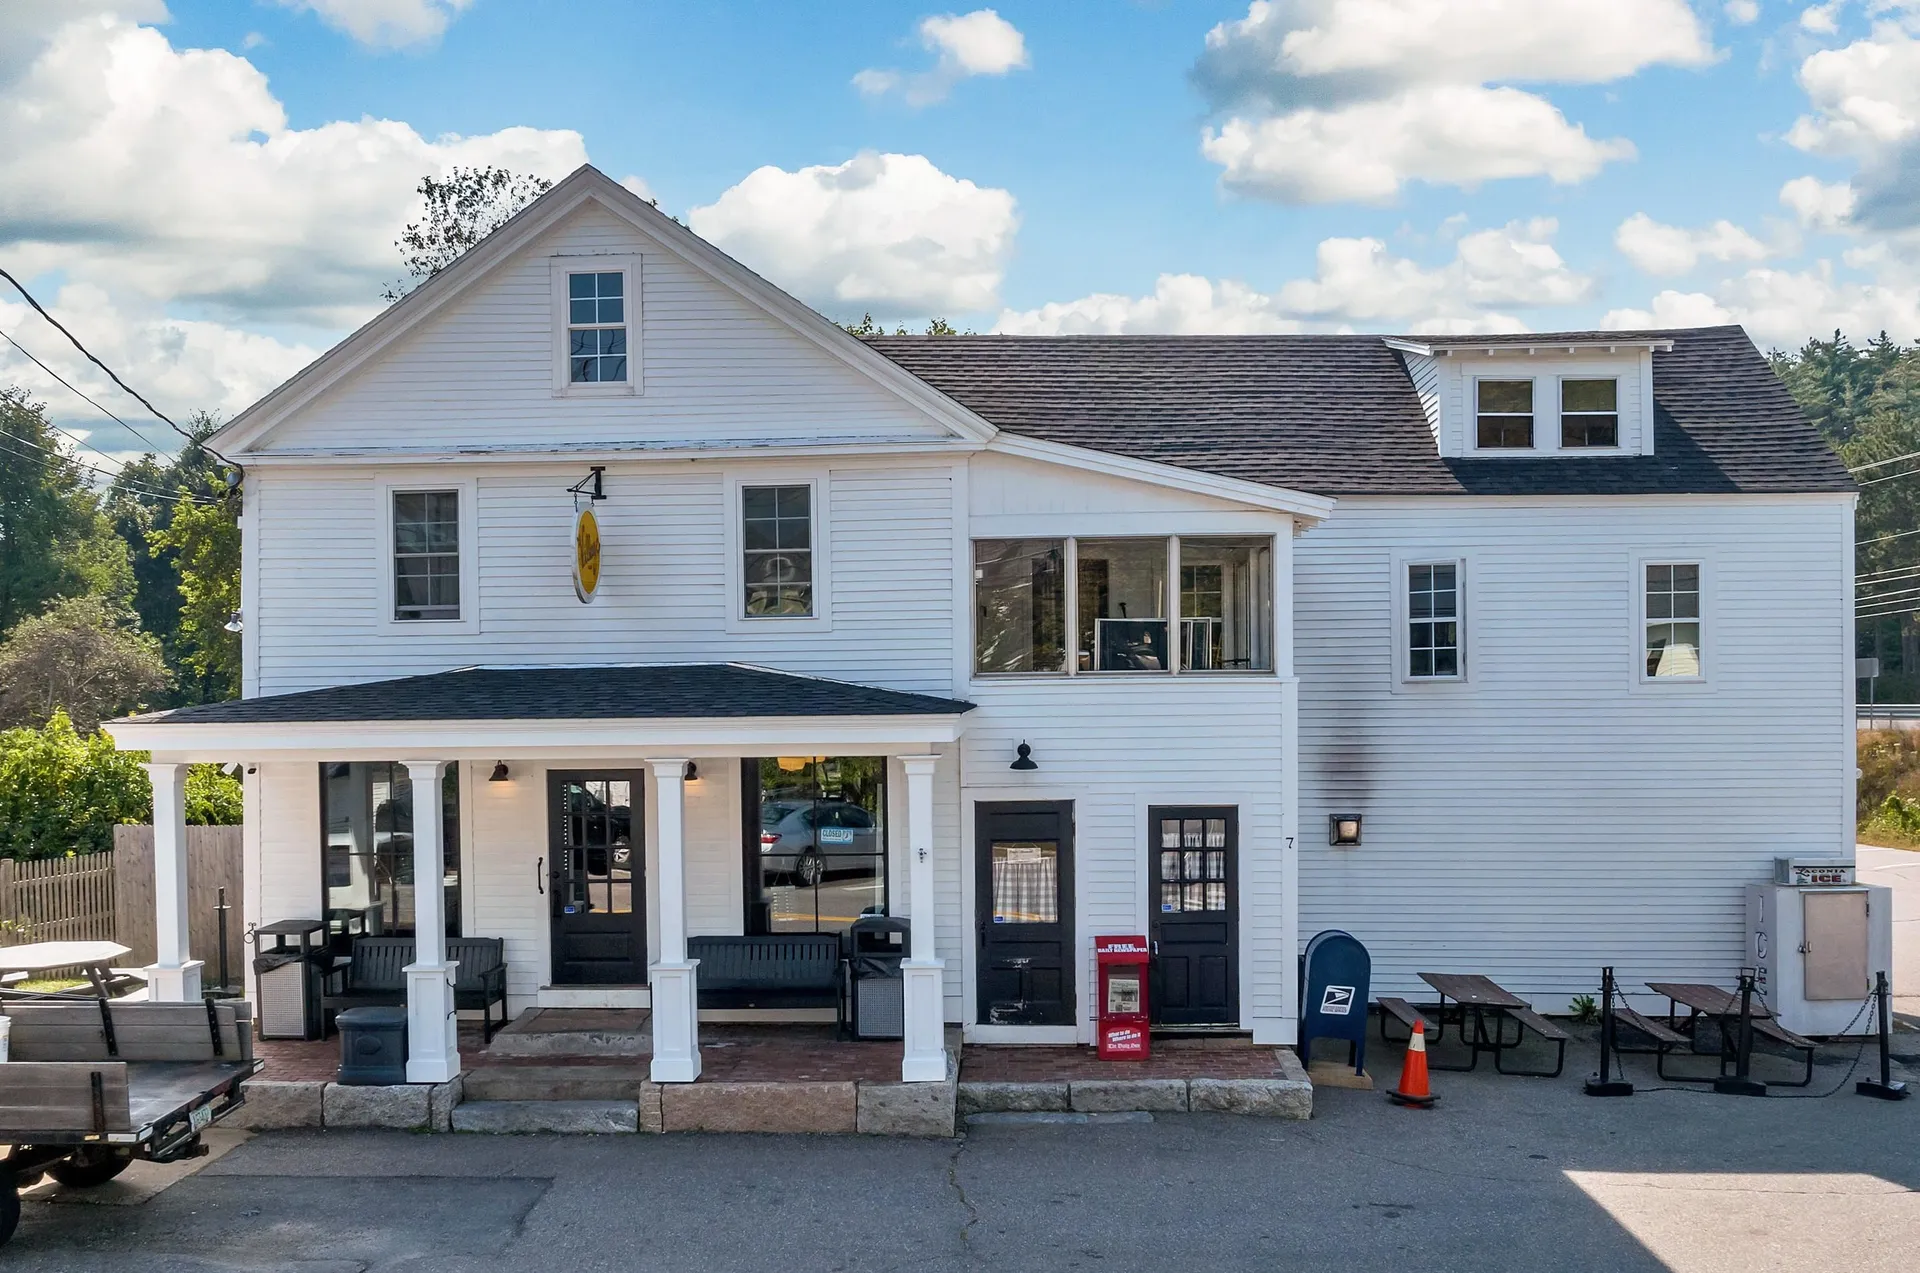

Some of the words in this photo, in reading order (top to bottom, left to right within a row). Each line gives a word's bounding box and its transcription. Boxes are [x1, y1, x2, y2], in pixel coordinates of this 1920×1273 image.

[822, 829, 841, 837] CLOSED
[1285, 837, 1294, 849] 7
[1795, 868, 1846, 877] LACONIA
[1811, 875, 1842, 883] ICE
